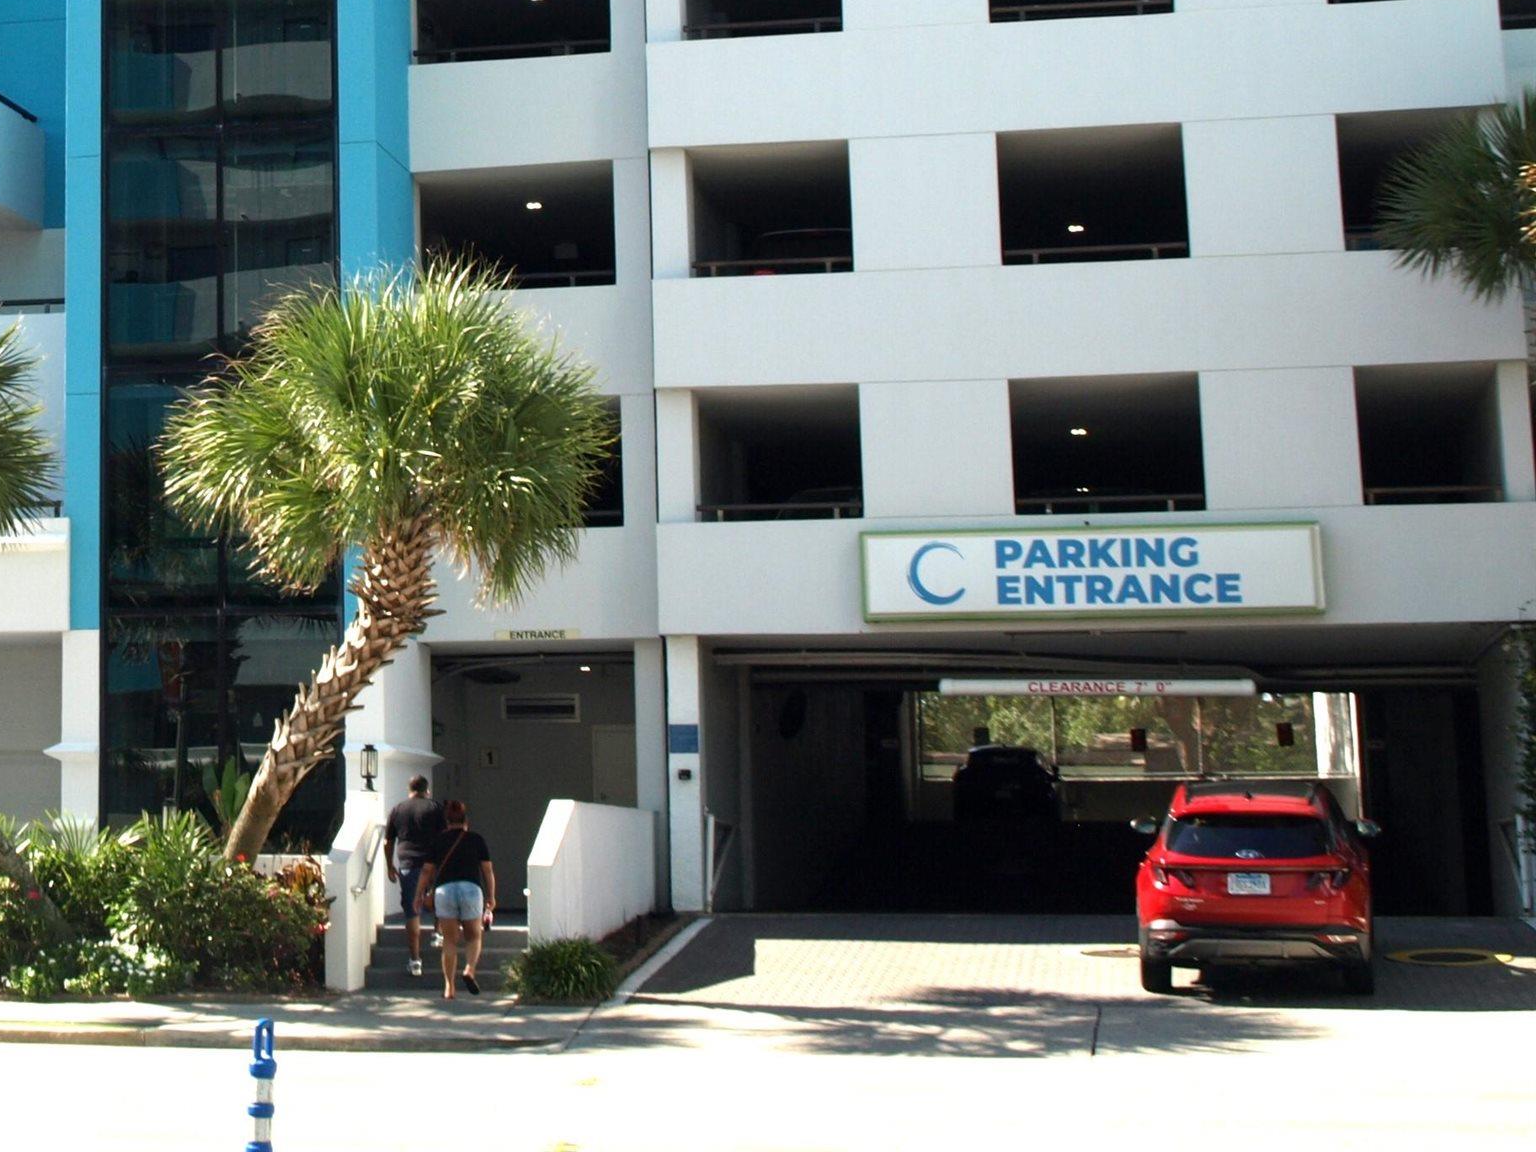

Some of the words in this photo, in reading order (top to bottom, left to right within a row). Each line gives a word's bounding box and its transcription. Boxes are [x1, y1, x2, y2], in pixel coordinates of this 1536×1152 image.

[994, 537, 1199, 569] PARKING
[996, 573, 1243, 605] ENTRANCE
[509, 630, 566, 640] ENTRANCE
[1027, 680, 1126, 693] CLEARANCE
